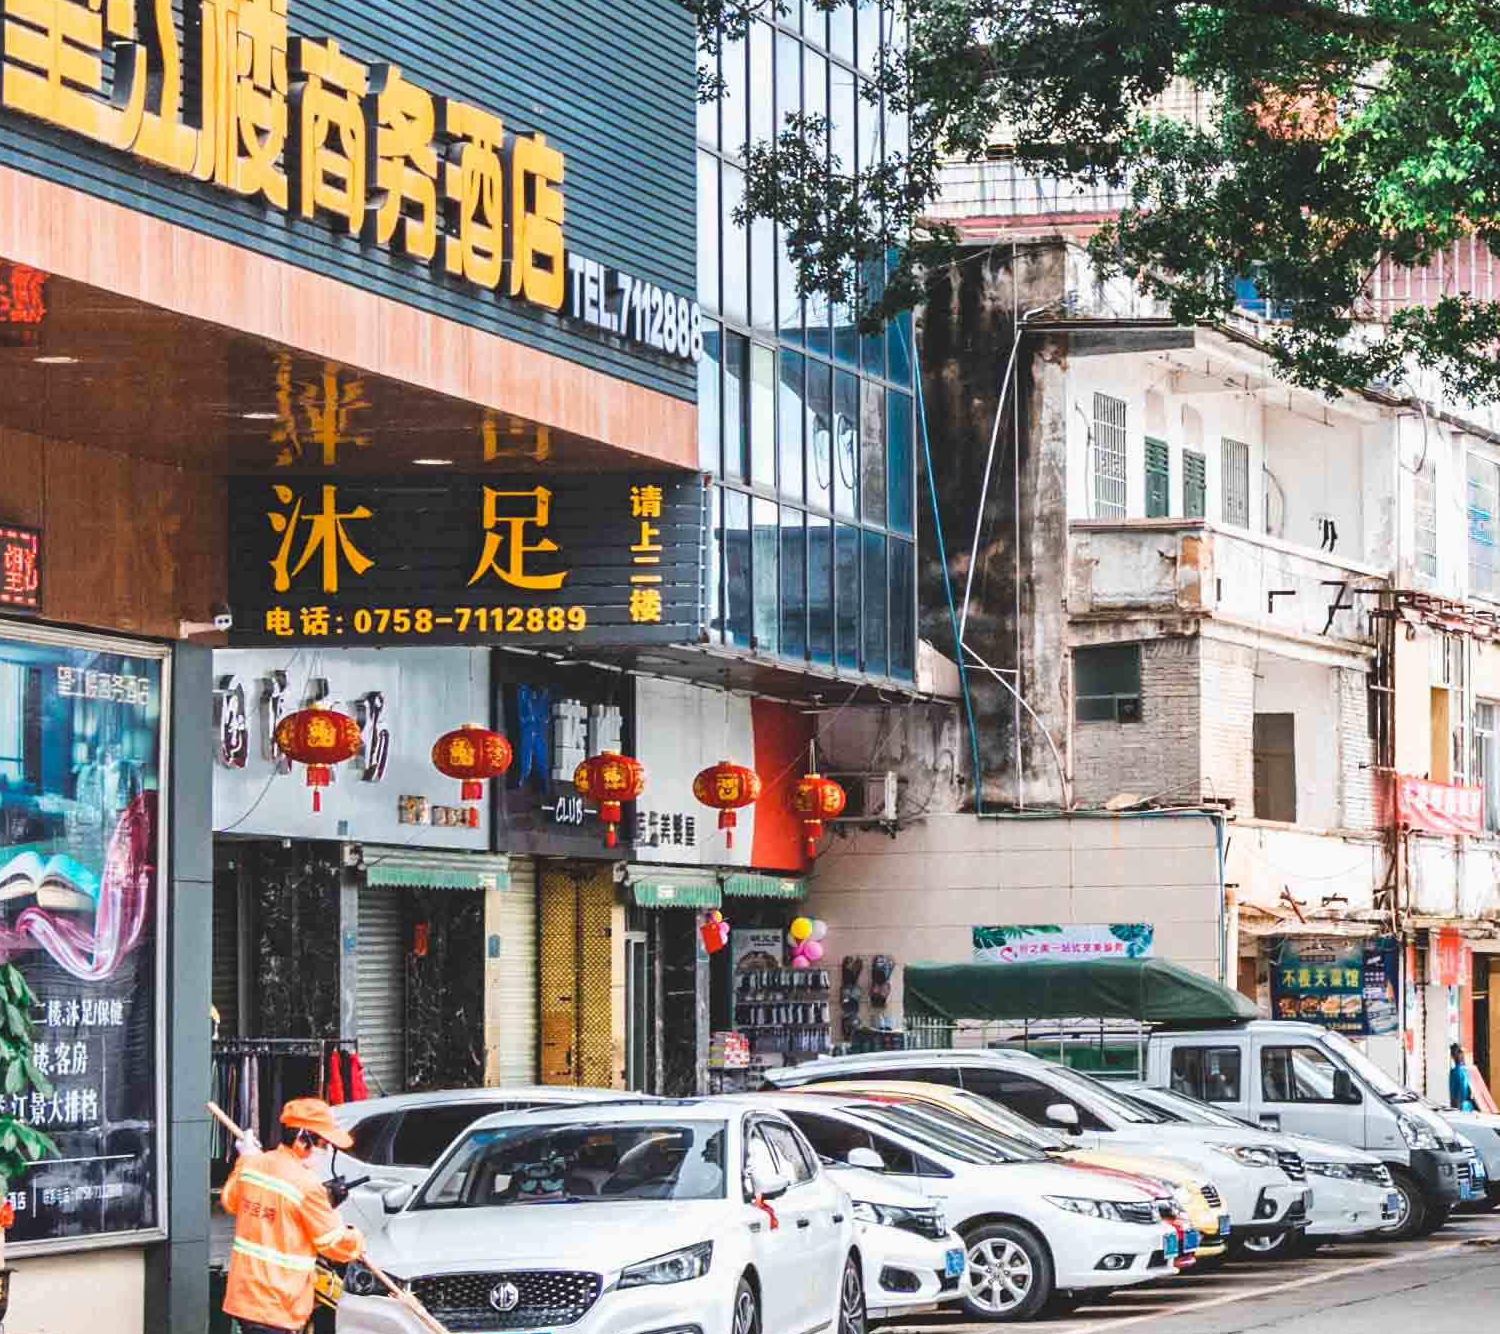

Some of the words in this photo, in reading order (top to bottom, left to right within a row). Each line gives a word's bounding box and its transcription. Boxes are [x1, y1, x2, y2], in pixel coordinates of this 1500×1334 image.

[267, 484, 569, 594] 沐足
[629, 485, 663, 623] 请上二楼
[554, 796, 584, 825] CLUB
